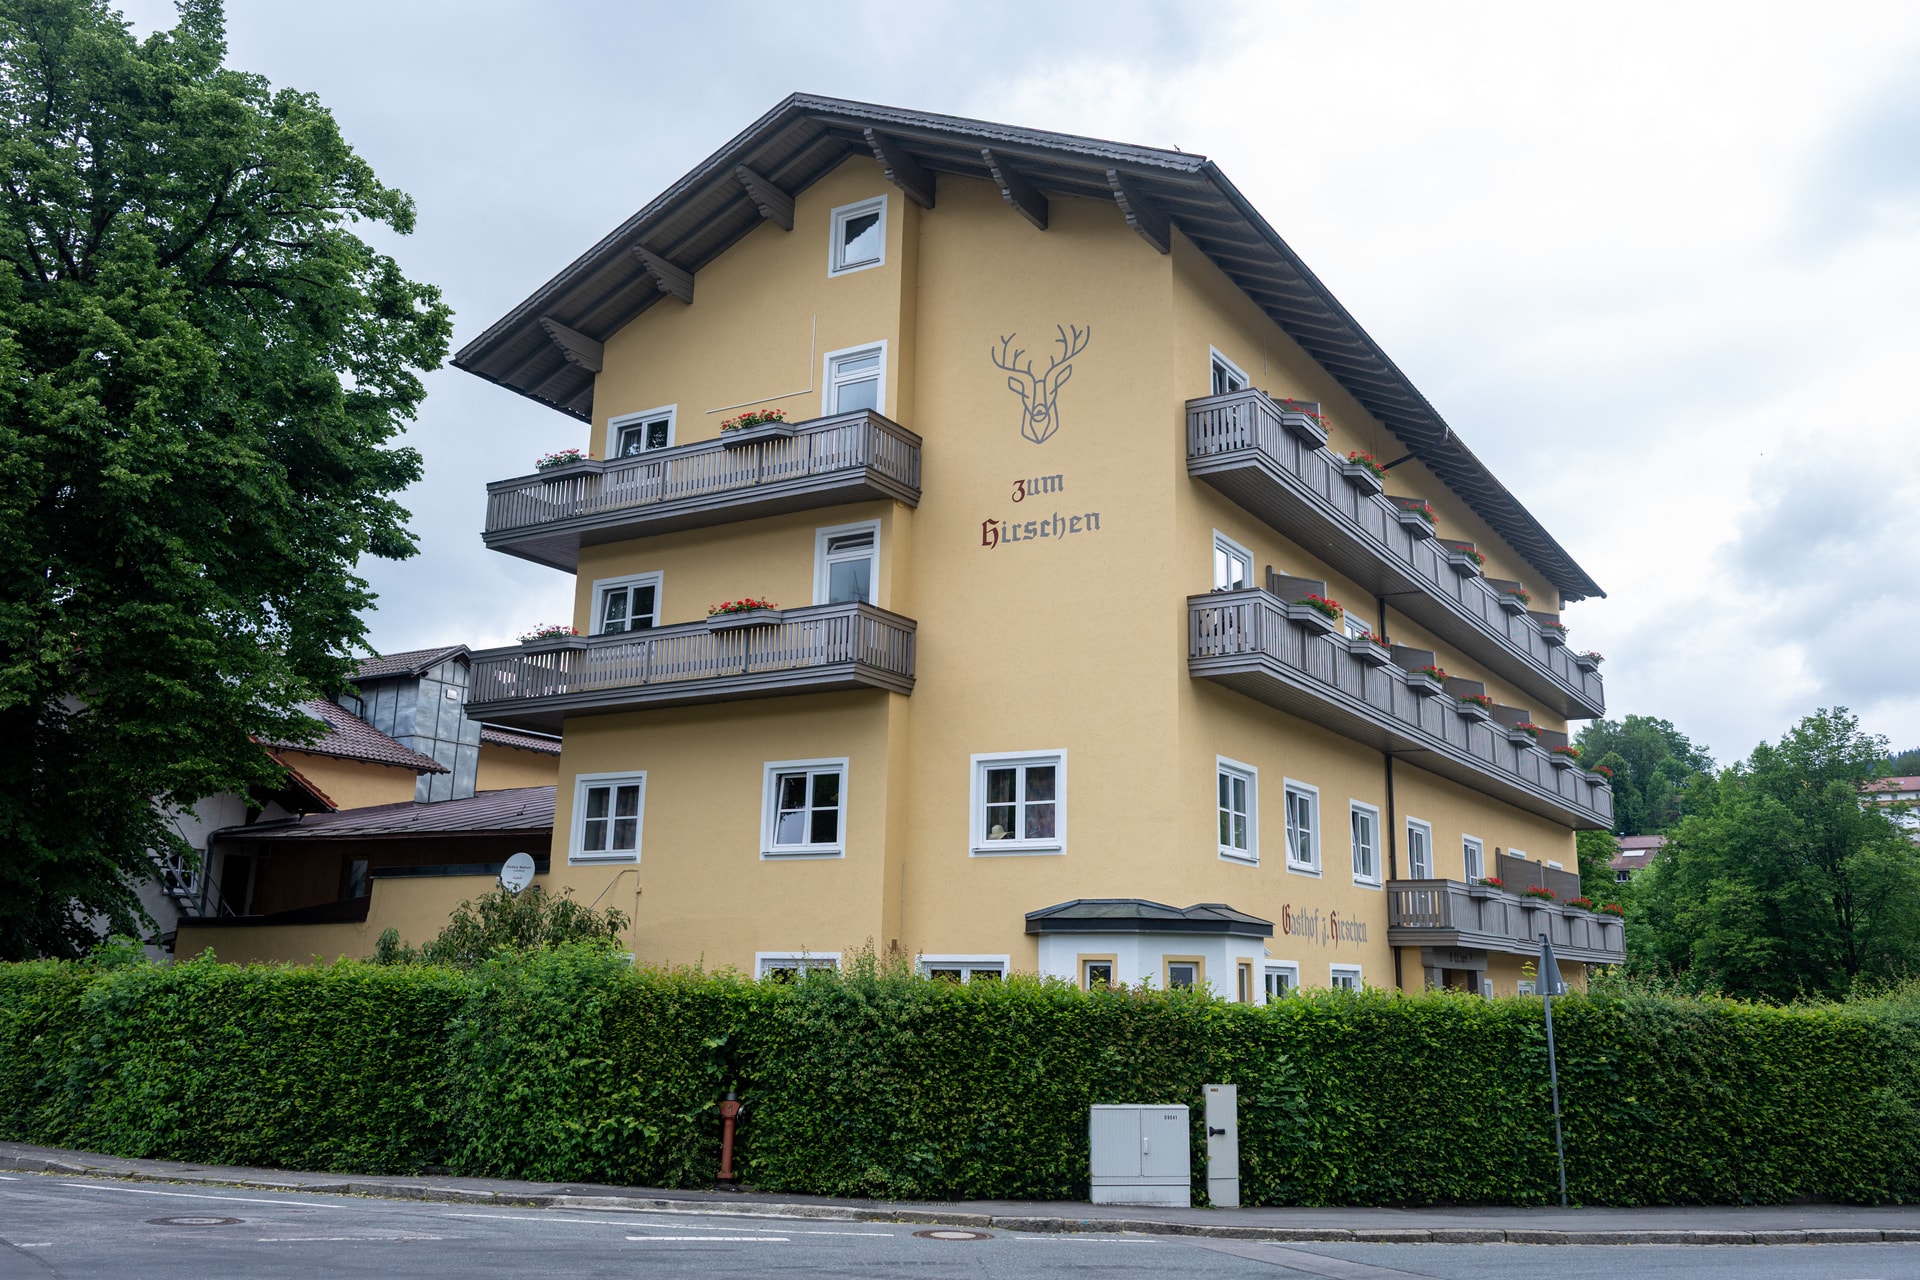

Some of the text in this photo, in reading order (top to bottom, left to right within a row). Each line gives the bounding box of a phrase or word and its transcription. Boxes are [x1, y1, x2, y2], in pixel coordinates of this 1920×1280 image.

[981, 511, 1101, 550] Hirschen
[1282, 903, 1319, 945] Gasthof
[1330, 909, 1368, 951] Hirschen
